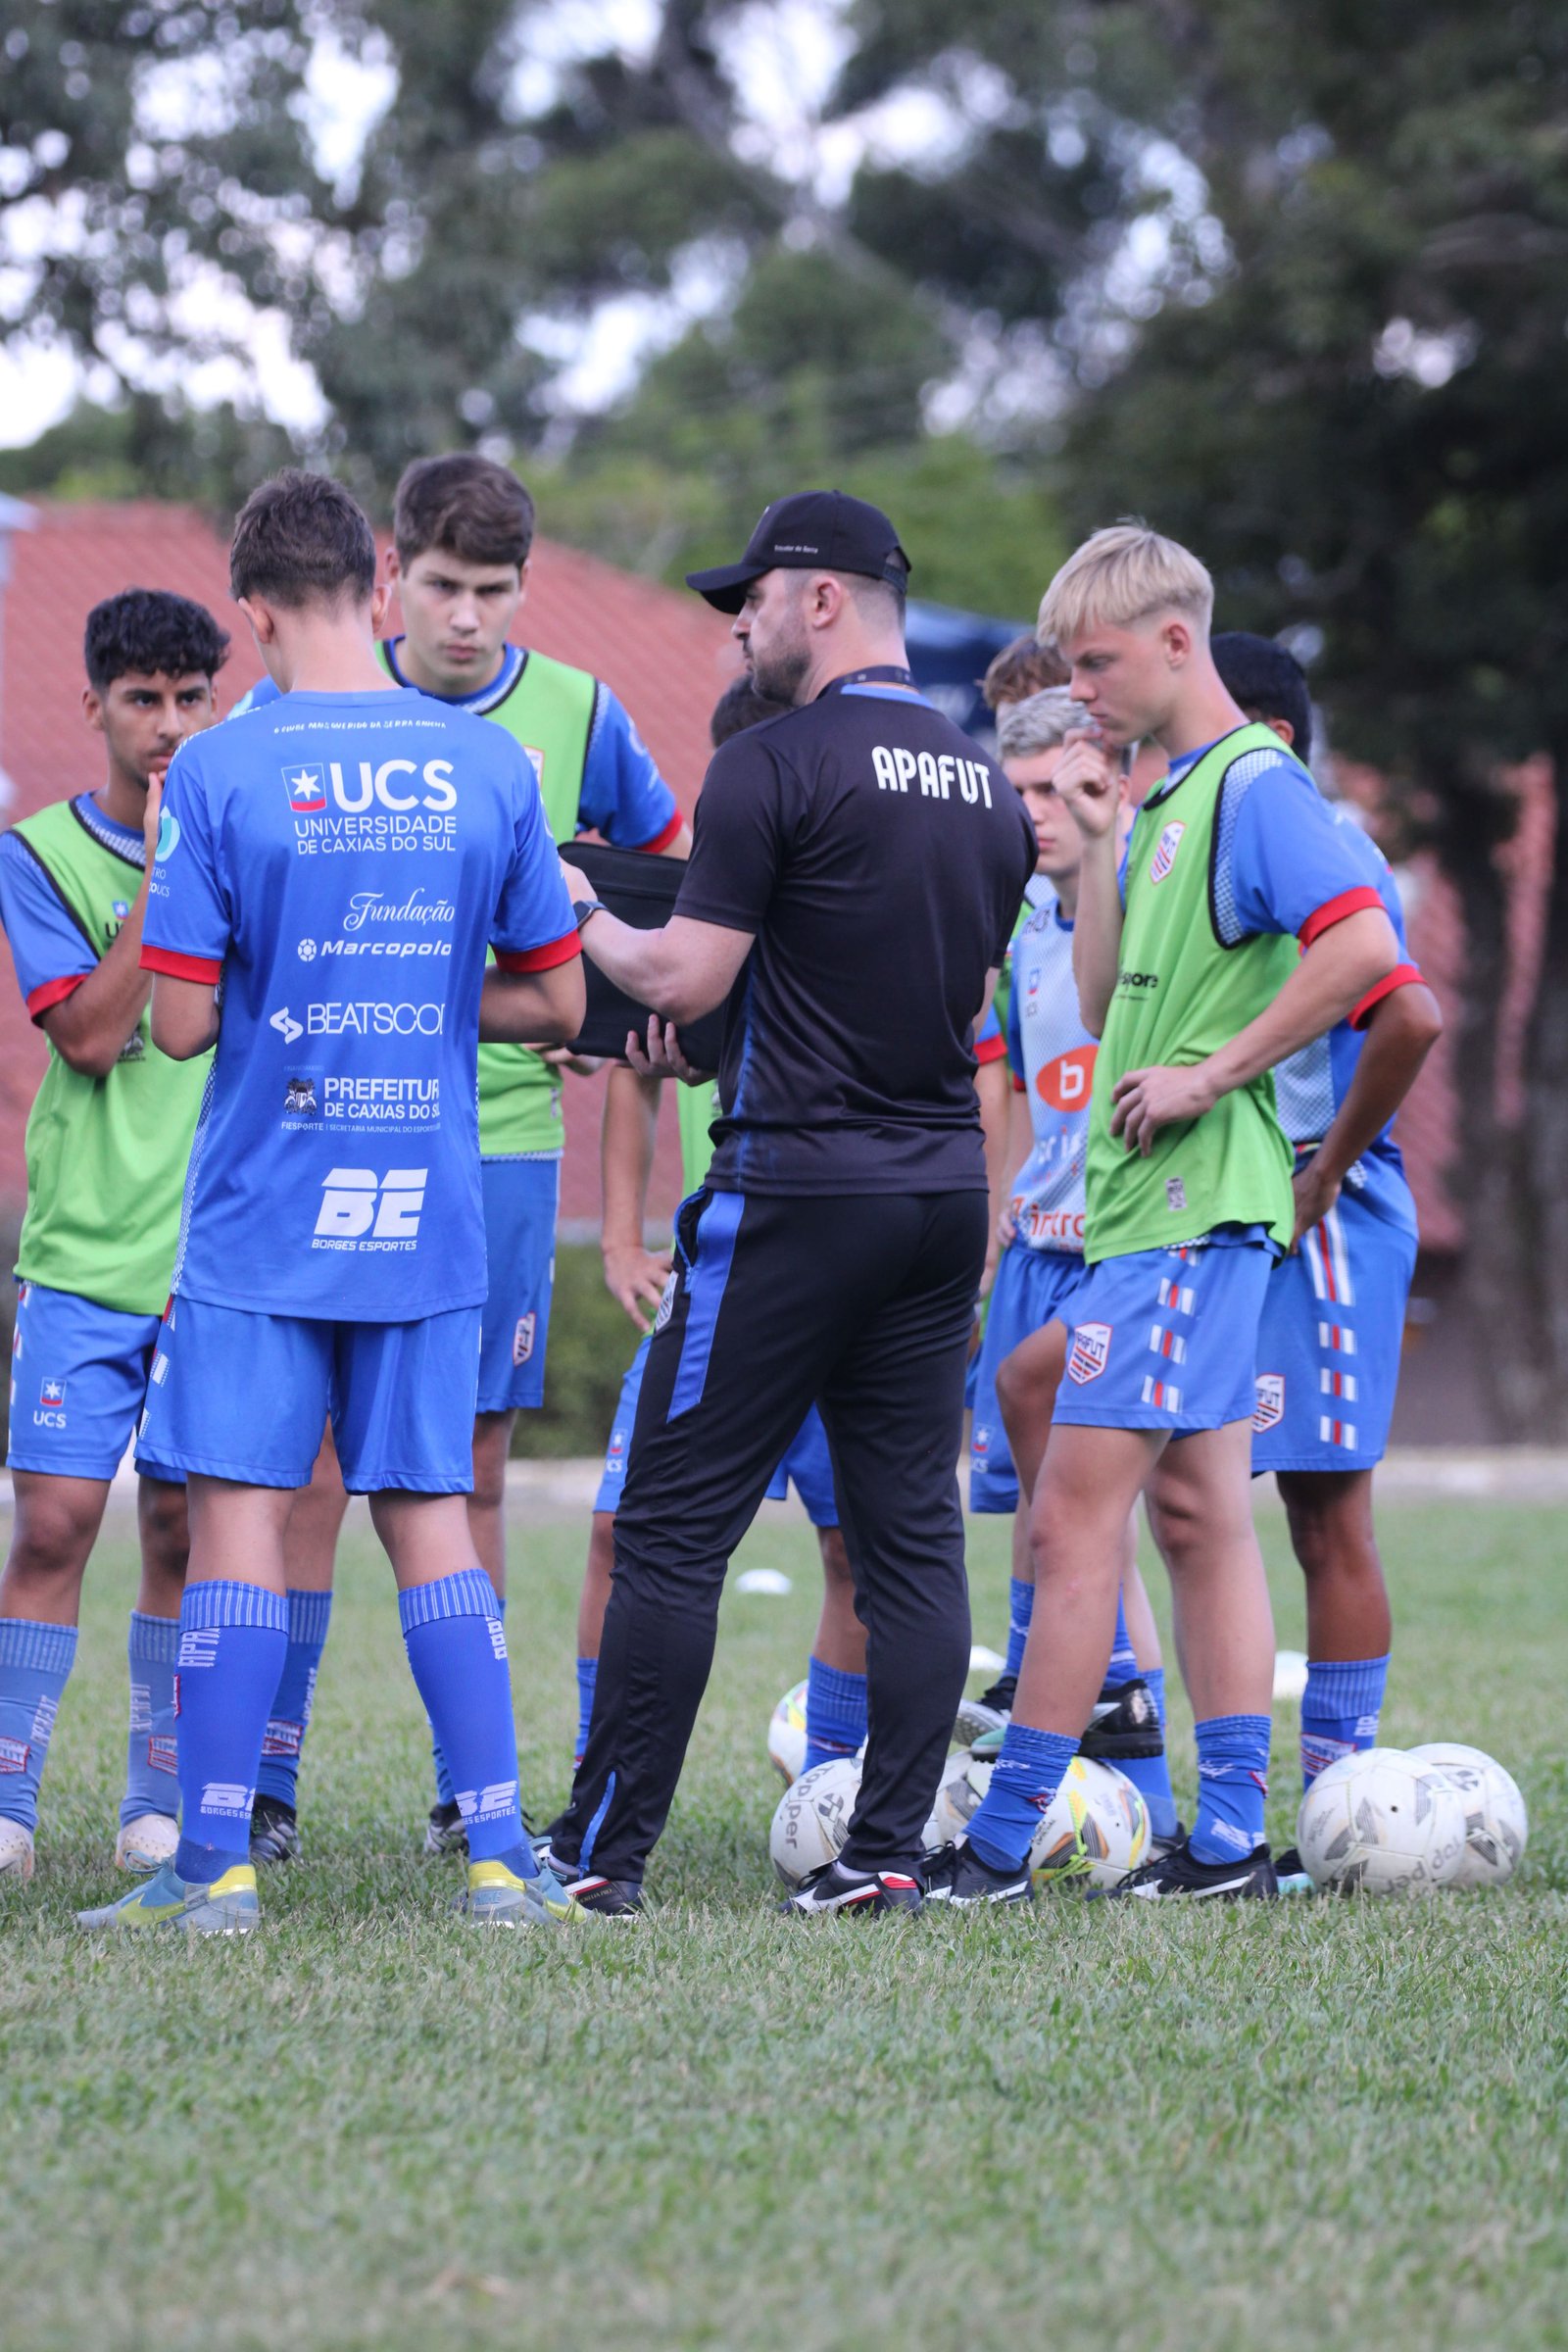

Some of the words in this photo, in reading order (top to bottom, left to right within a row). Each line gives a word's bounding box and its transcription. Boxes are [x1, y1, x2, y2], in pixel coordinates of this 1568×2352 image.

[369, 720, 382, 729] DA
[329, 759, 458, 813] UCS
[871, 745, 993, 809] APAFUT
[294, 815, 458, 838] UNIVERSIDADE
[297, 839, 318, 856] DE
[321, 837, 387, 854] CAXIAS
[392, 836, 417, 852] DO
[422, 836, 456, 852] SUL
[343, 887, 456, 932] Fundação
[320, 939, 452, 957] Marcopolo
[324, 1102, 345, 1118] DE
[347, 1103, 406, 1120] CAXIAS
[409, 1103, 430, 1120] DO
[280, 1121, 324, 1131] FIESPORTE
[329, 1123, 366, 1133] SECRETARIA
[367, 1124, 402, 1134] MUNICIPAL
[403, 1124, 413, 1134] DO
[314, 1167, 428, 1238] BE
[311, 1239, 358, 1251] BORGES
[359, 1240, 417, 1251] ESPORTES
[32, 1410, 67, 1429] UCS
[785, 1764, 835, 1850] Topper
